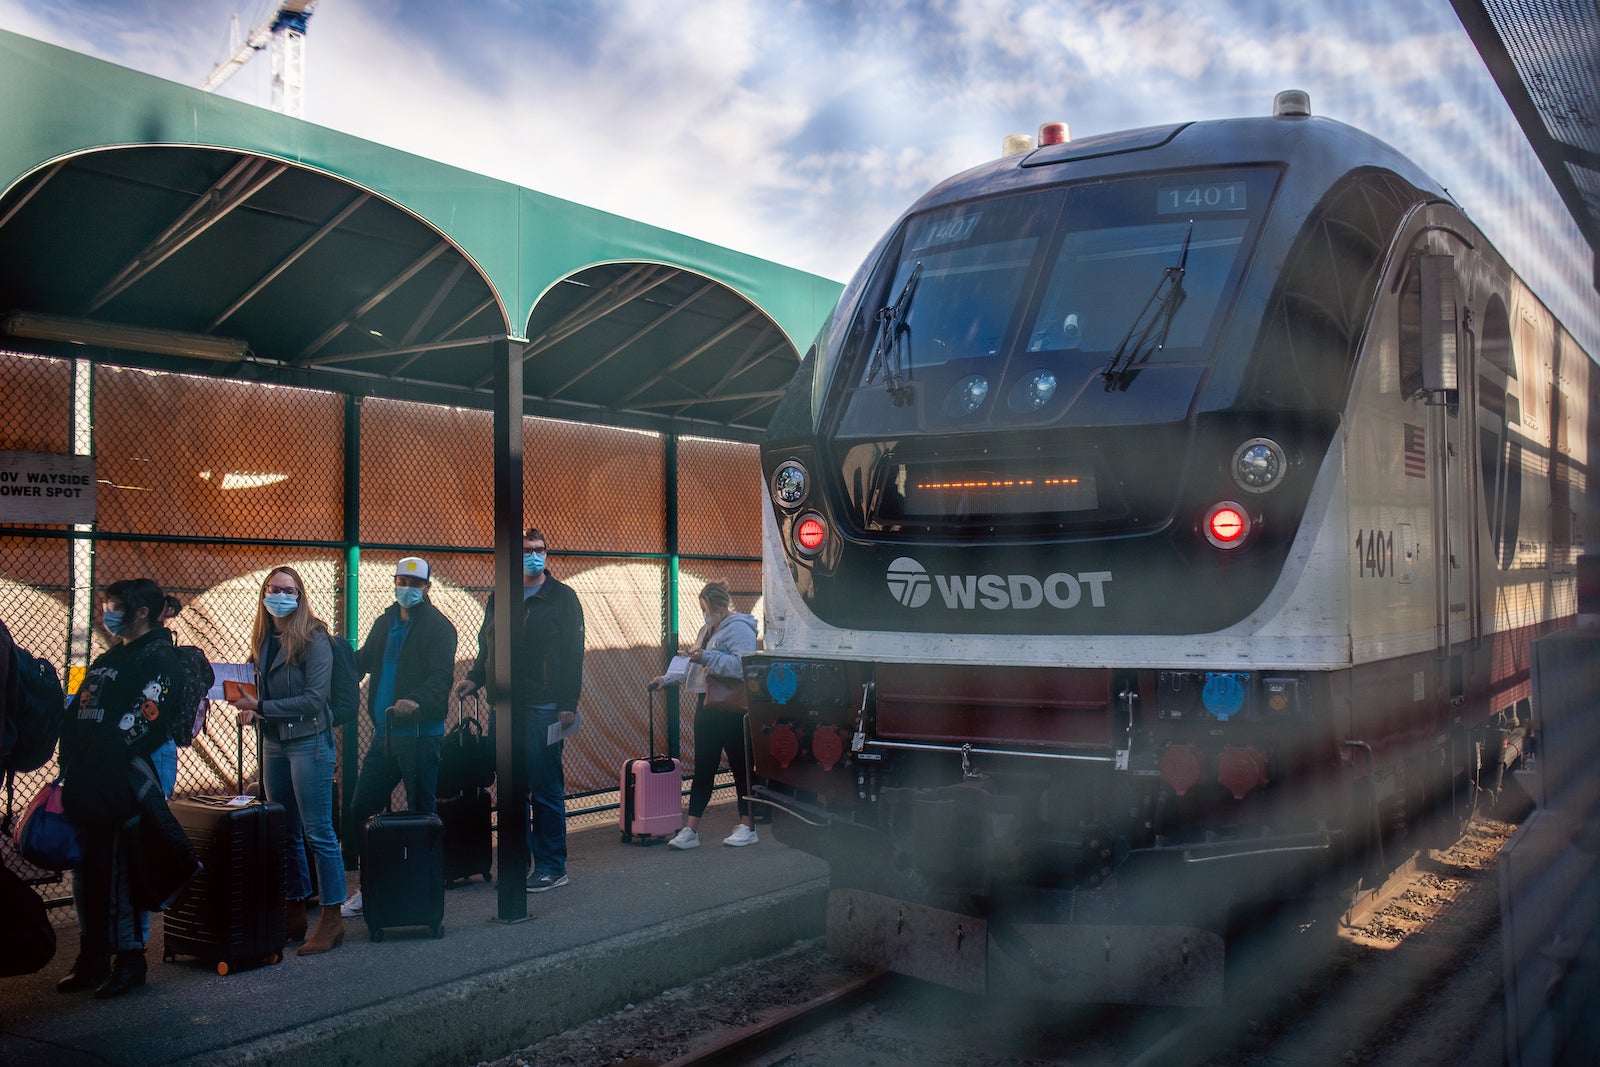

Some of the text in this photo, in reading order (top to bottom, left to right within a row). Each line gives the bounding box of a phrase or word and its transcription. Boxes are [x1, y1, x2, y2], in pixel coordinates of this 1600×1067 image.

[1168, 184, 1237, 208] 1401
[926, 215, 977, 243] 1401
[27, 472, 90, 486] WAYSIDE
[46, 486, 83, 498] SPOT
[1355, 528, 1395, 578] 1401
[934, 570, 1113, 611] WSDOT
